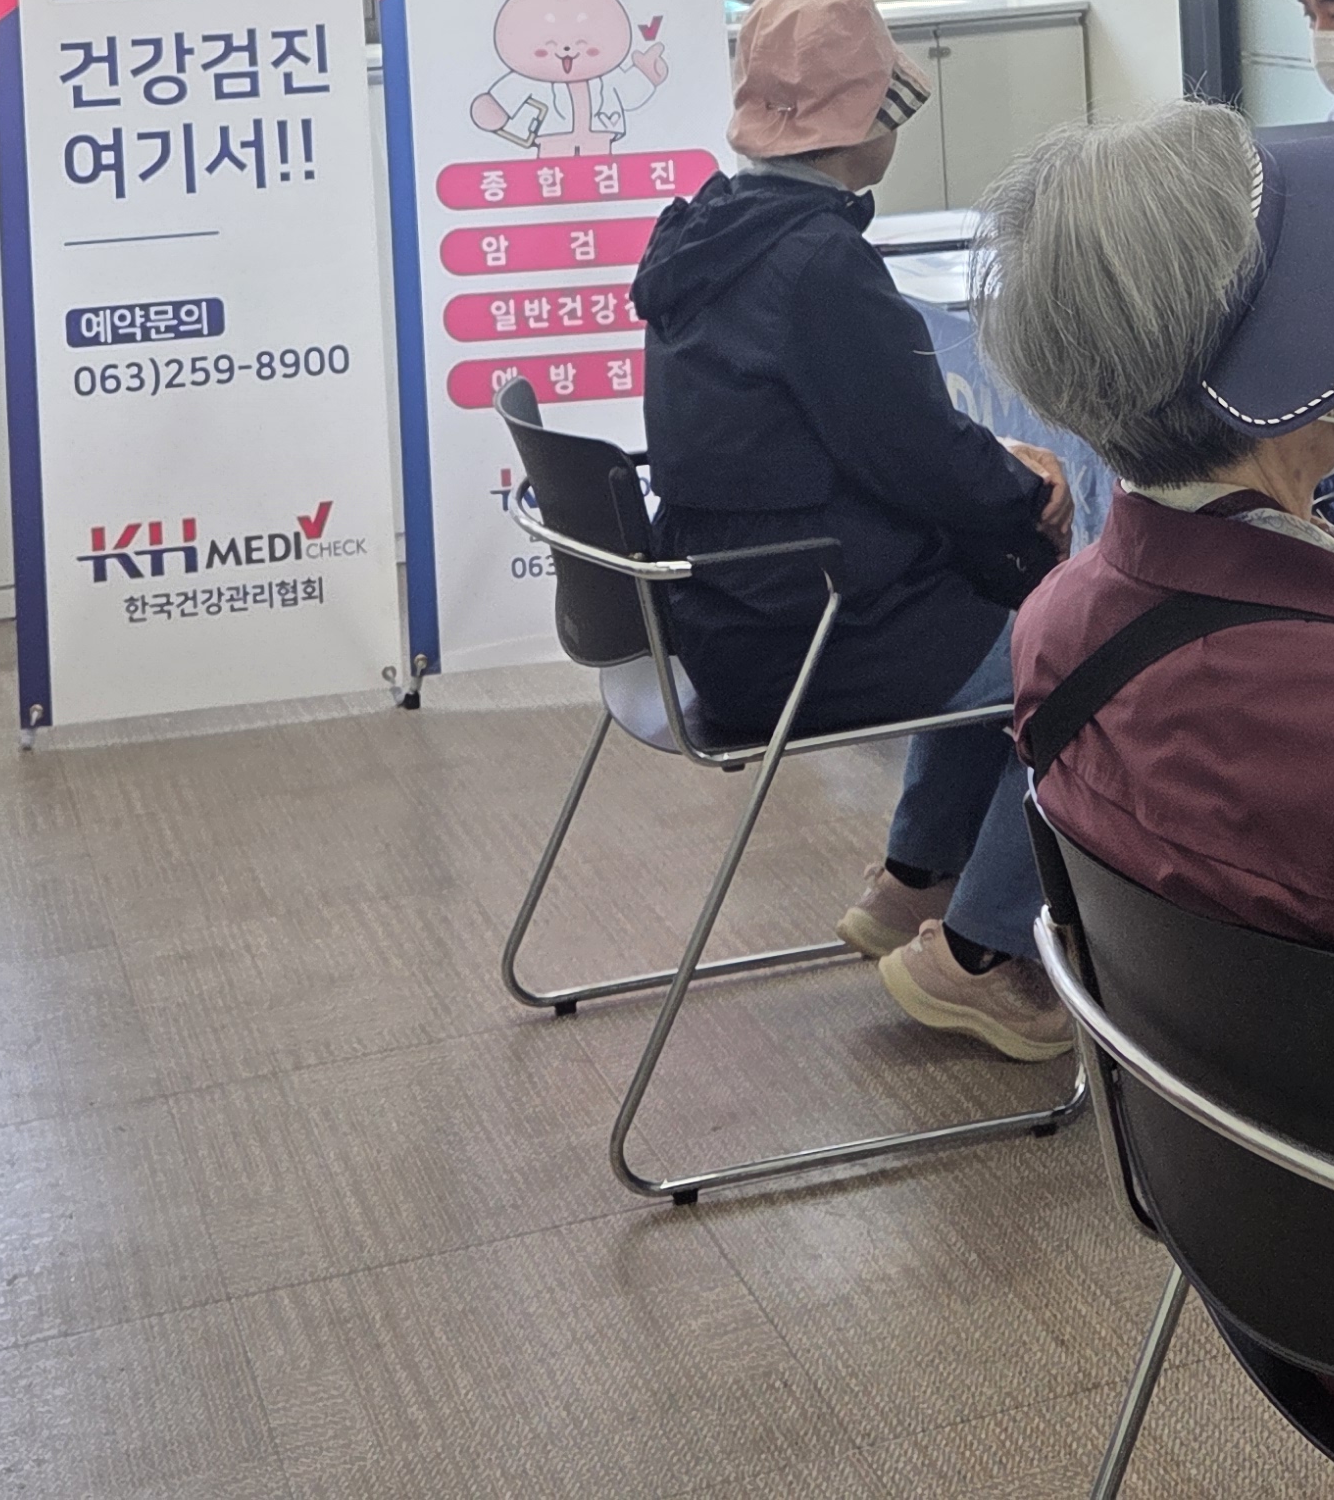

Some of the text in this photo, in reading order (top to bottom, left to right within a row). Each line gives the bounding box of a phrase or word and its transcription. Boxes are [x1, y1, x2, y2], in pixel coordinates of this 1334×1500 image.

[59, 23, 331, 109] 건강검진
[64, 117, 316, 200] 여기서!!
[79, 301, 210, 344] 예약문의
[73, 344, 351, 397] 063)259-8900
[205, 531, 303, 570] MEDI
[305, 537, 368, 560] CHECK
[123, 576, 325, 623] 한국건강관리협회
